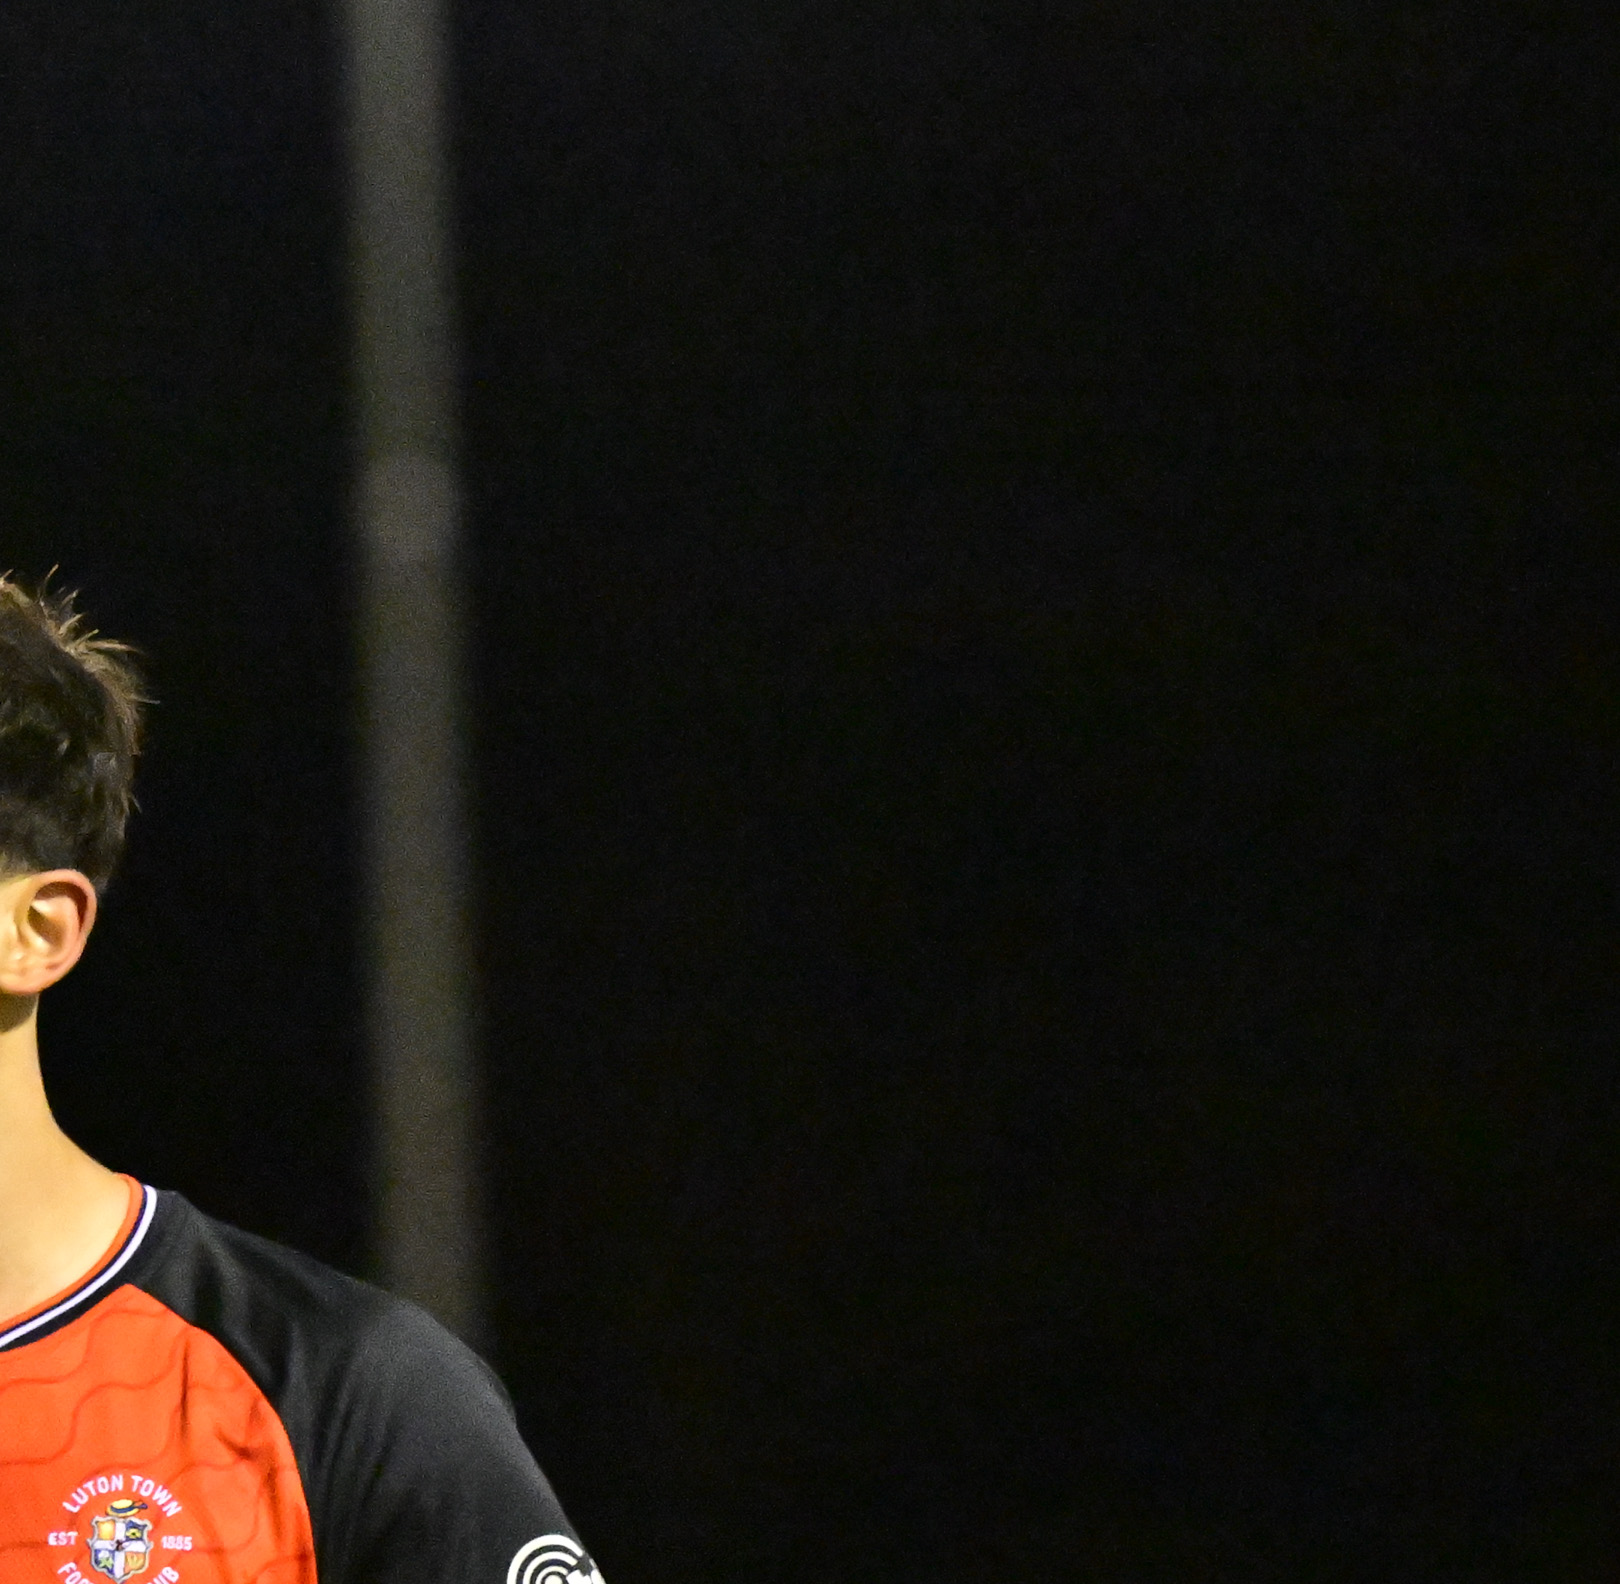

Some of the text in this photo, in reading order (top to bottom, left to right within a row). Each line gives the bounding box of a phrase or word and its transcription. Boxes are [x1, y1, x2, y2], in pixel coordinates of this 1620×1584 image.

[62, 1474, 182, 1517] LUTON TOWN
[47, 1531, 193, 1551] EST 1885
